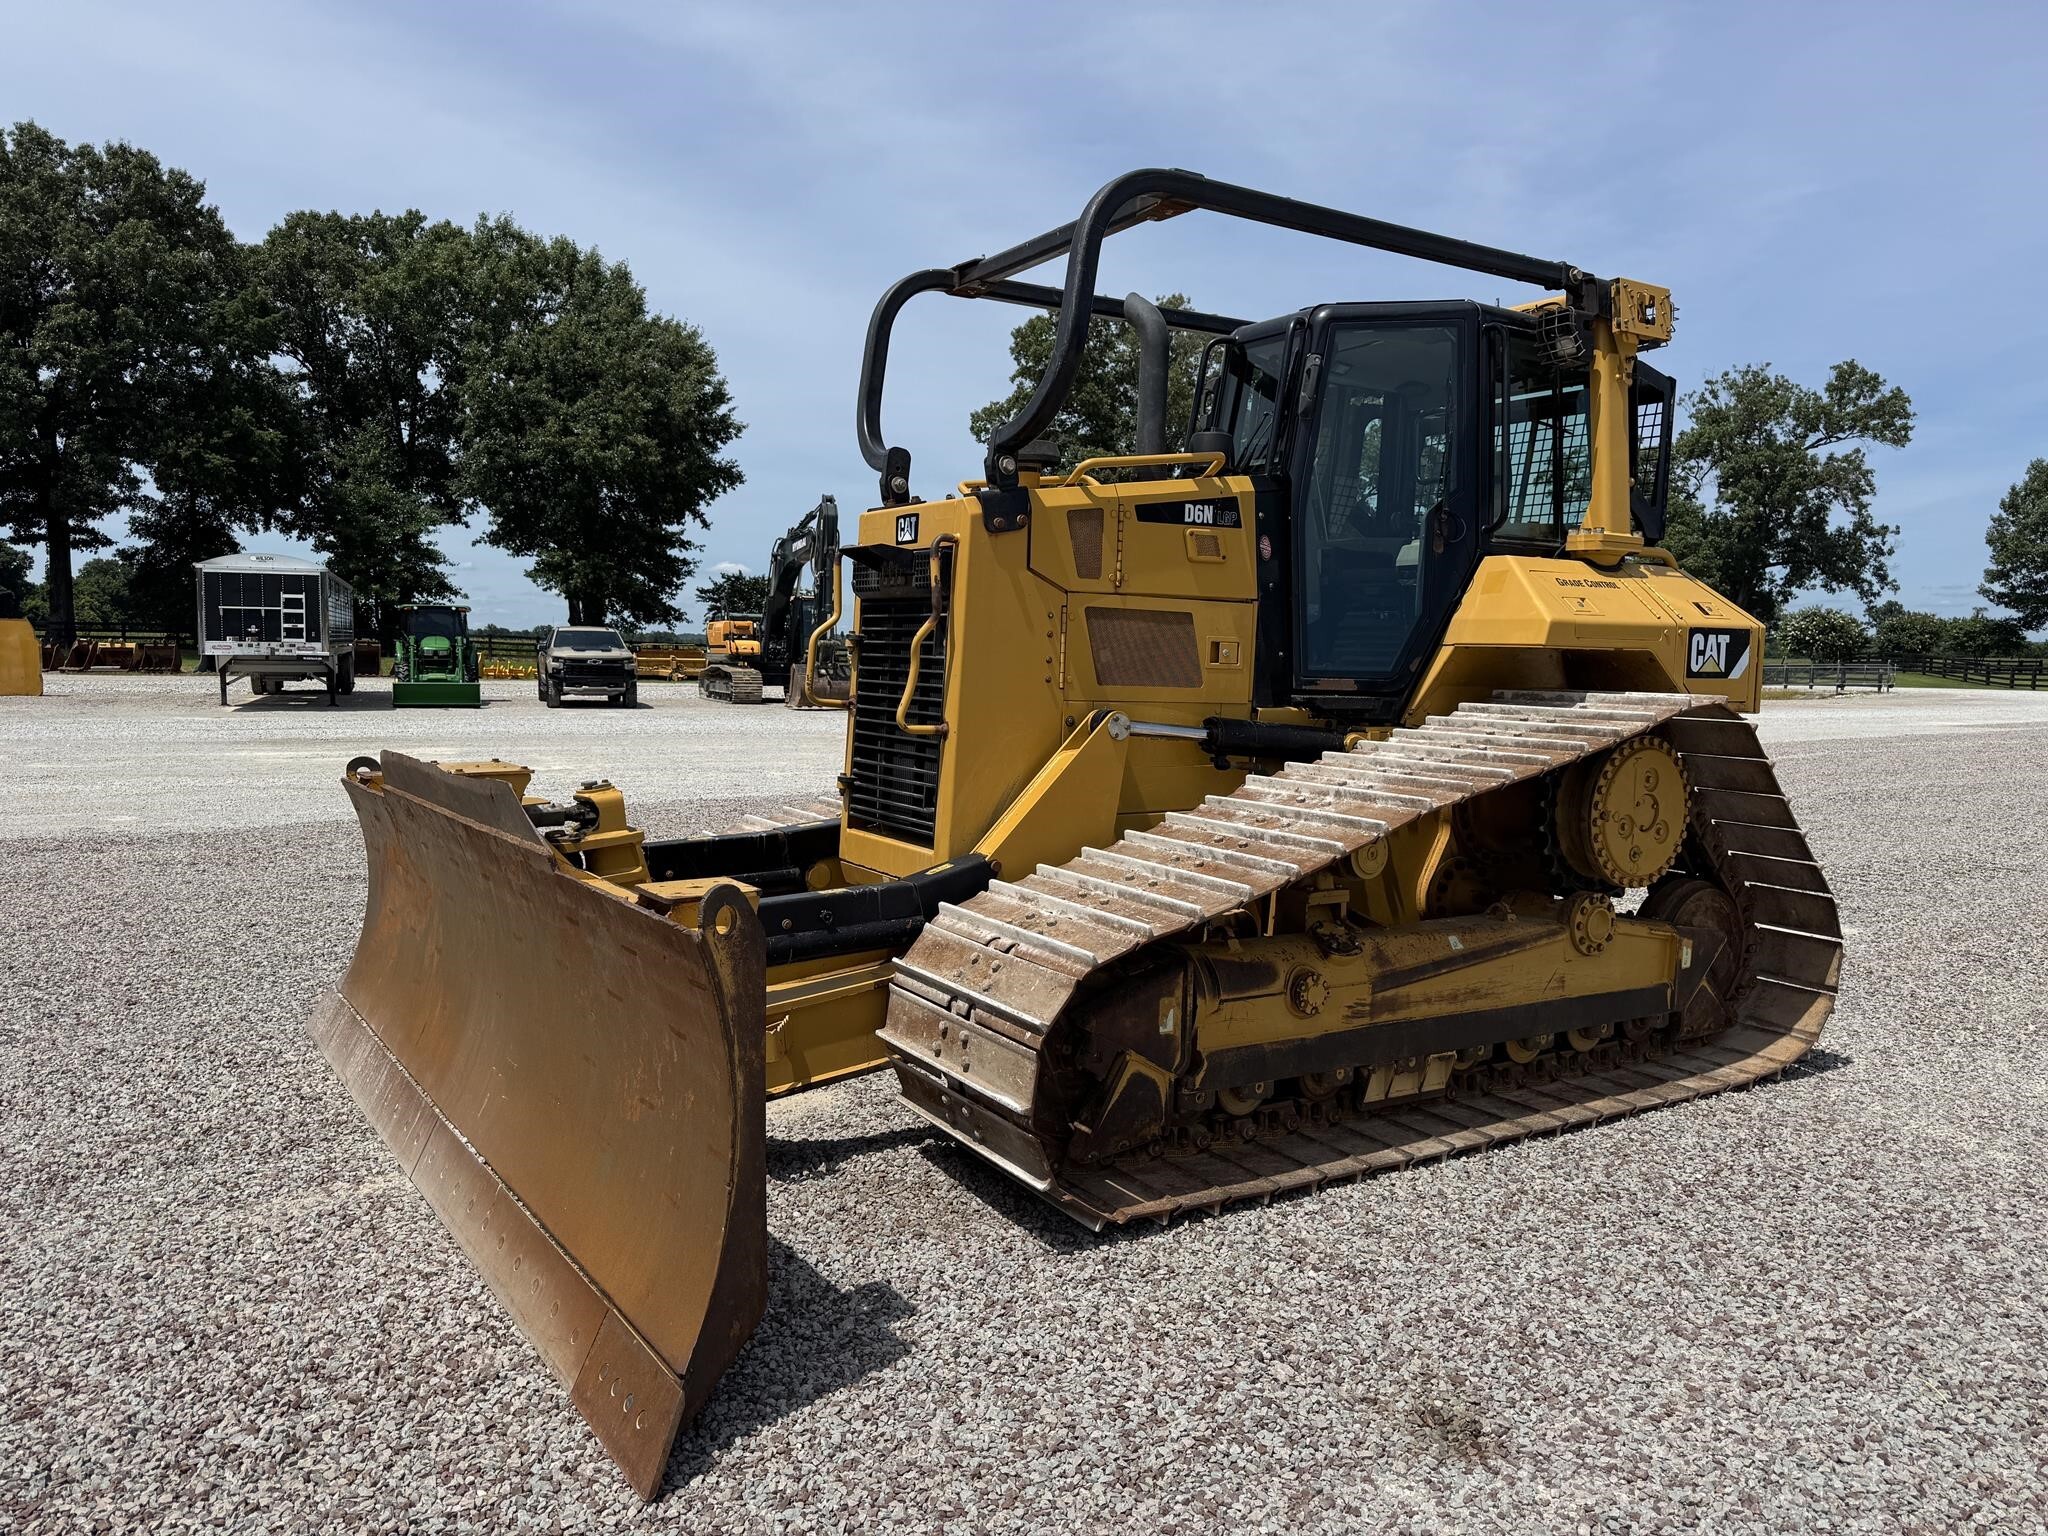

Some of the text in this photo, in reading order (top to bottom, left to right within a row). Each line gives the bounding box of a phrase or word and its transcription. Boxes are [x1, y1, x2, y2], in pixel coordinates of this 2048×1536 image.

[1184, 503, 1213, 524] D6N
[898, 516, 917, 542] CAT
[1690, 633, 1730, 673] CAT
